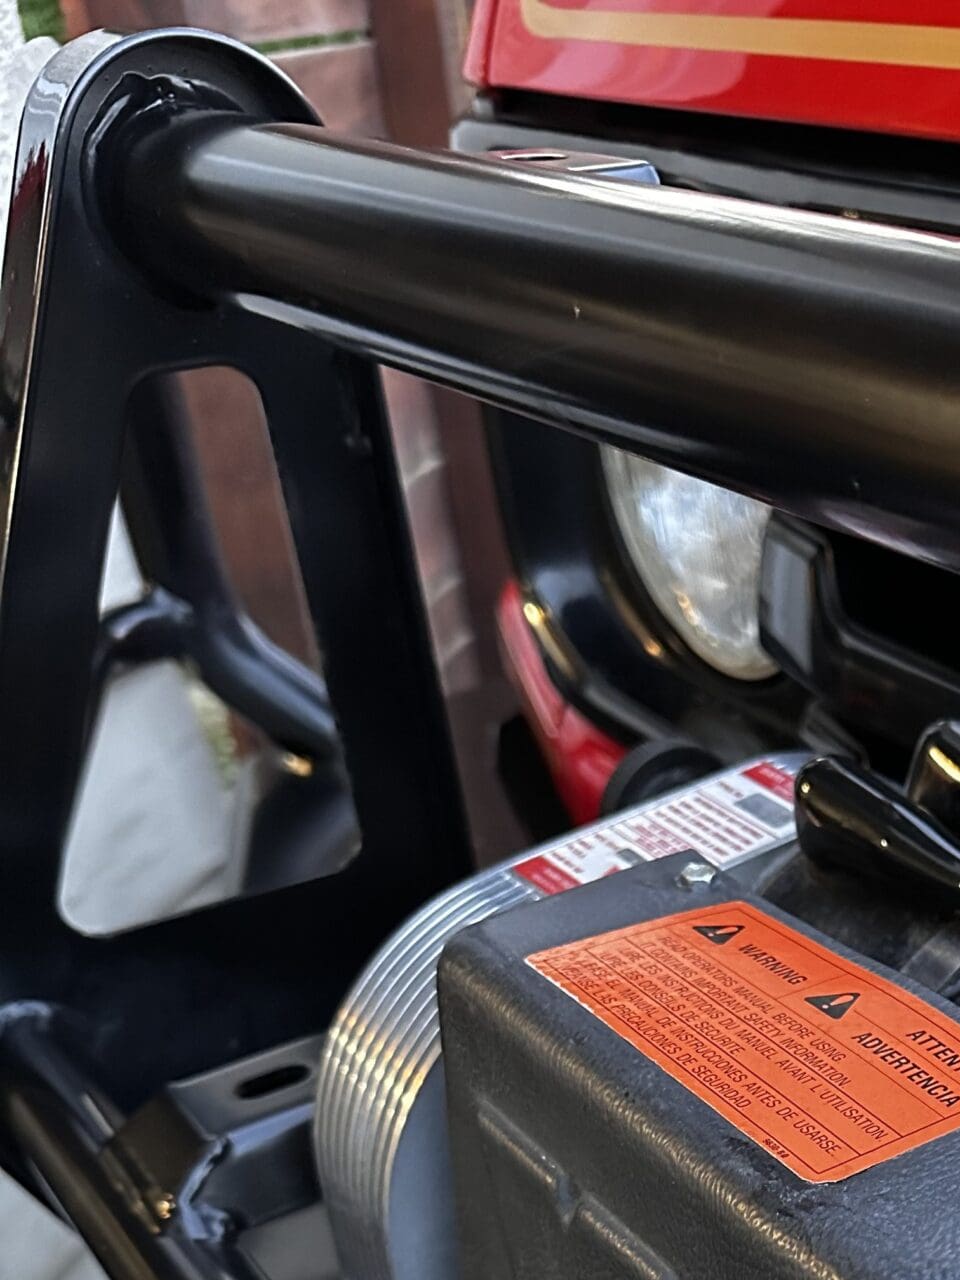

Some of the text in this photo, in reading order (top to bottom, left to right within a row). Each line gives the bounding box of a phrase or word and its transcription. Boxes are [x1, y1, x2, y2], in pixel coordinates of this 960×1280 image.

[618, 966, 646, 981] LES
[635, 979, 688, 1012] CONSEILS
[677, 1009, 702, 1022] DE
[657, 935, 689, 953] READ
[680, 951, 739, 987] OPERATORS
[730, 985, 778, 1014] MANUAL
[769, 1012, 816, 1039] BEFORE
[734, 943, 809, 986] WARNING
[590, 989, 619, 1004] LAS
[609, 1003, 684, 1055] PRECAUCIONES
[674, 1053, 698, 1066] DE
[603, 978, 625, 989] EL
[616, 988, 663, 1018] MANUAL
[653, 1016, 678, 1028] DE
[668, 1027, 749, 1083] INSTRUCCIONES
[739, 1080, 784, 1108] ANTES
[773, 1106, 800, 1121] DE
[790, 1119, 846, 1157] USARSE.
[636, 960, 665, 975] LES
[654, 973, 727, 1020] INSTRUCTIONS
[716, 1017, 742, 1031] DU
[731, 1028, 782, 1060] MANUEL
[772, 1058, 817, 1085] AVANT
[647, 947, 699, 978] CONTAINS
[689, 976, 751, 1014] IMPORTANT
[741, 1012, 786, 1039] SAFETY
[776, 1037, 856, 1089] INFORMATION.
